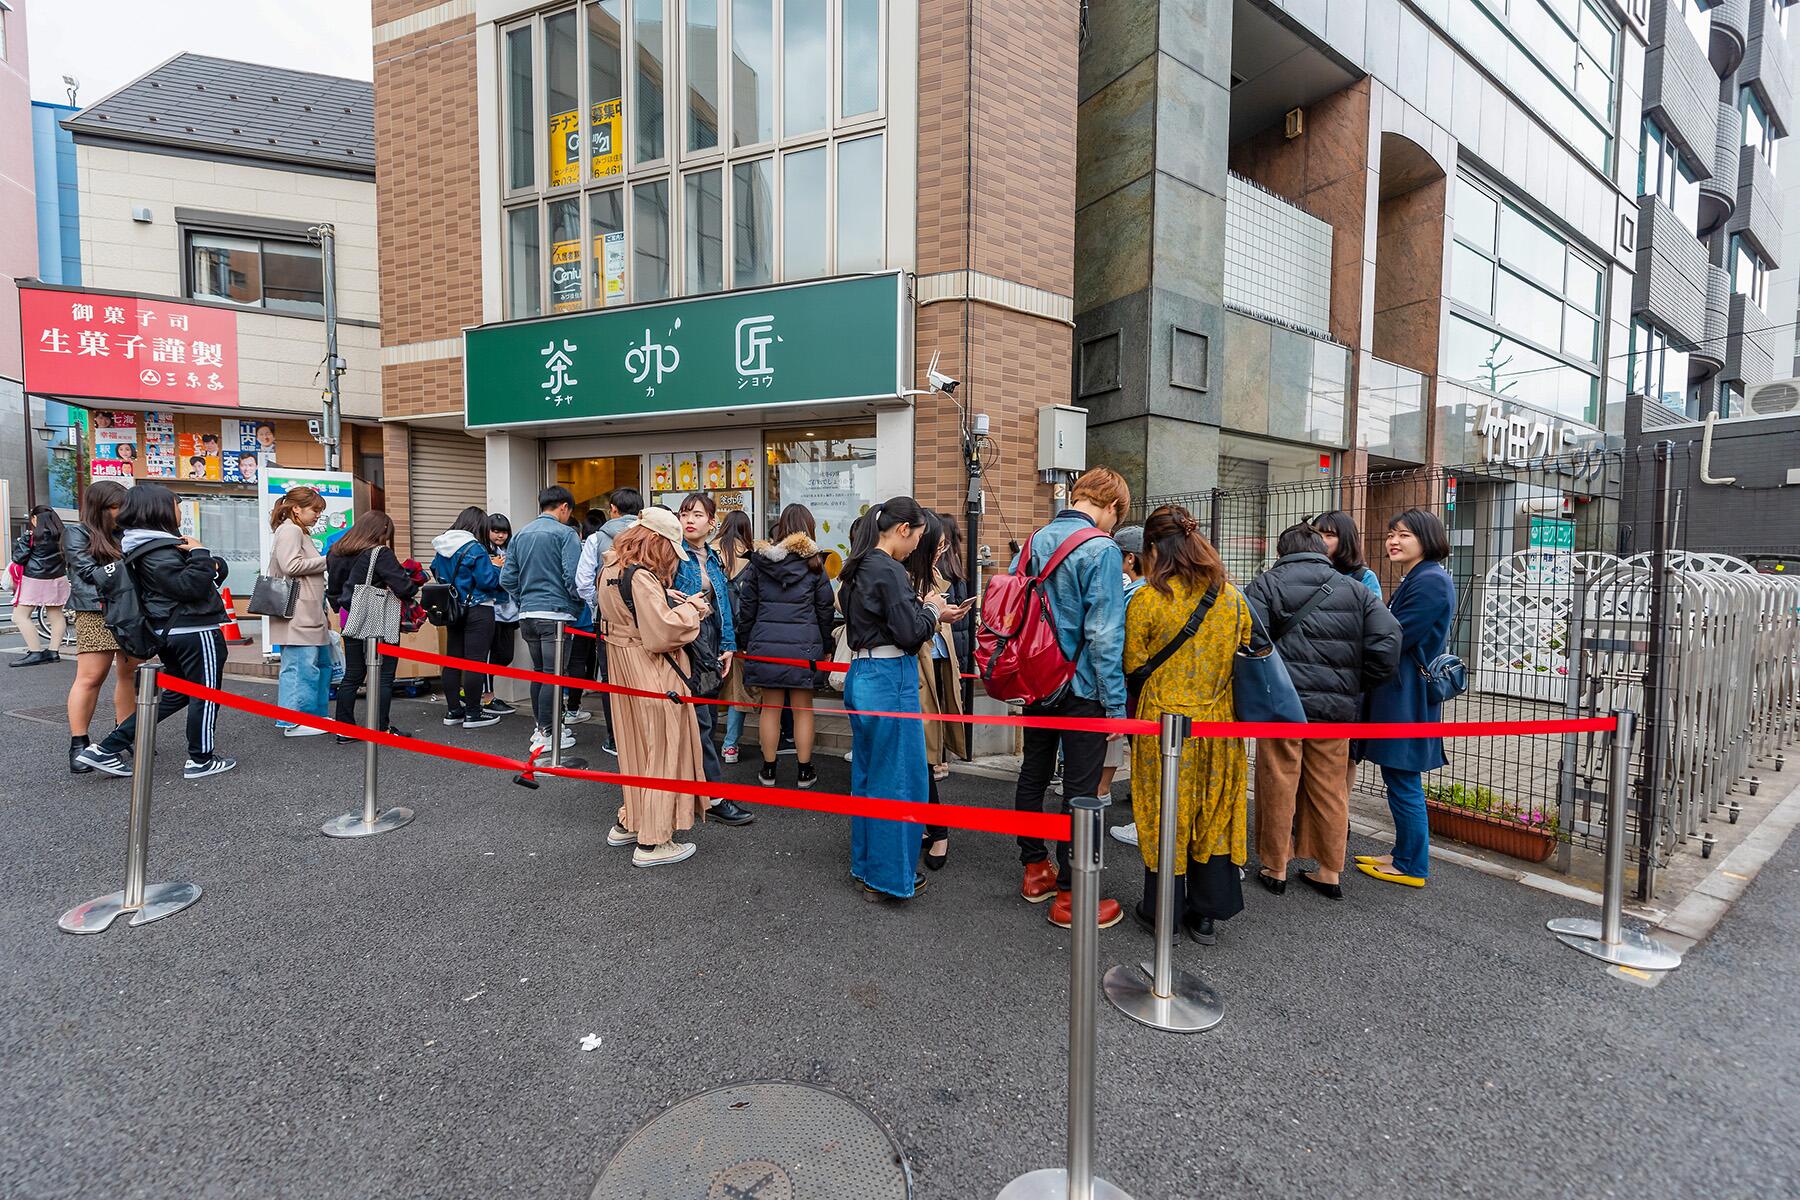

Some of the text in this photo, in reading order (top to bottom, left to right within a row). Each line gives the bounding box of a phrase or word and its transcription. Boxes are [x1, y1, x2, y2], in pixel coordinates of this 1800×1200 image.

[550, 101, 622, 133] テナン募集中
[71, 303, 189, 331] 御菓子司
[39, 327, 224, 368] 生菓子謹製
[737, 376, 773, 389] ショウ
[646, 386, 655, 398] カ
[554, 395, 573, 407] チャ
[241, 425, 256, 446] 山内
[93, 464, 121, 475] 北島
